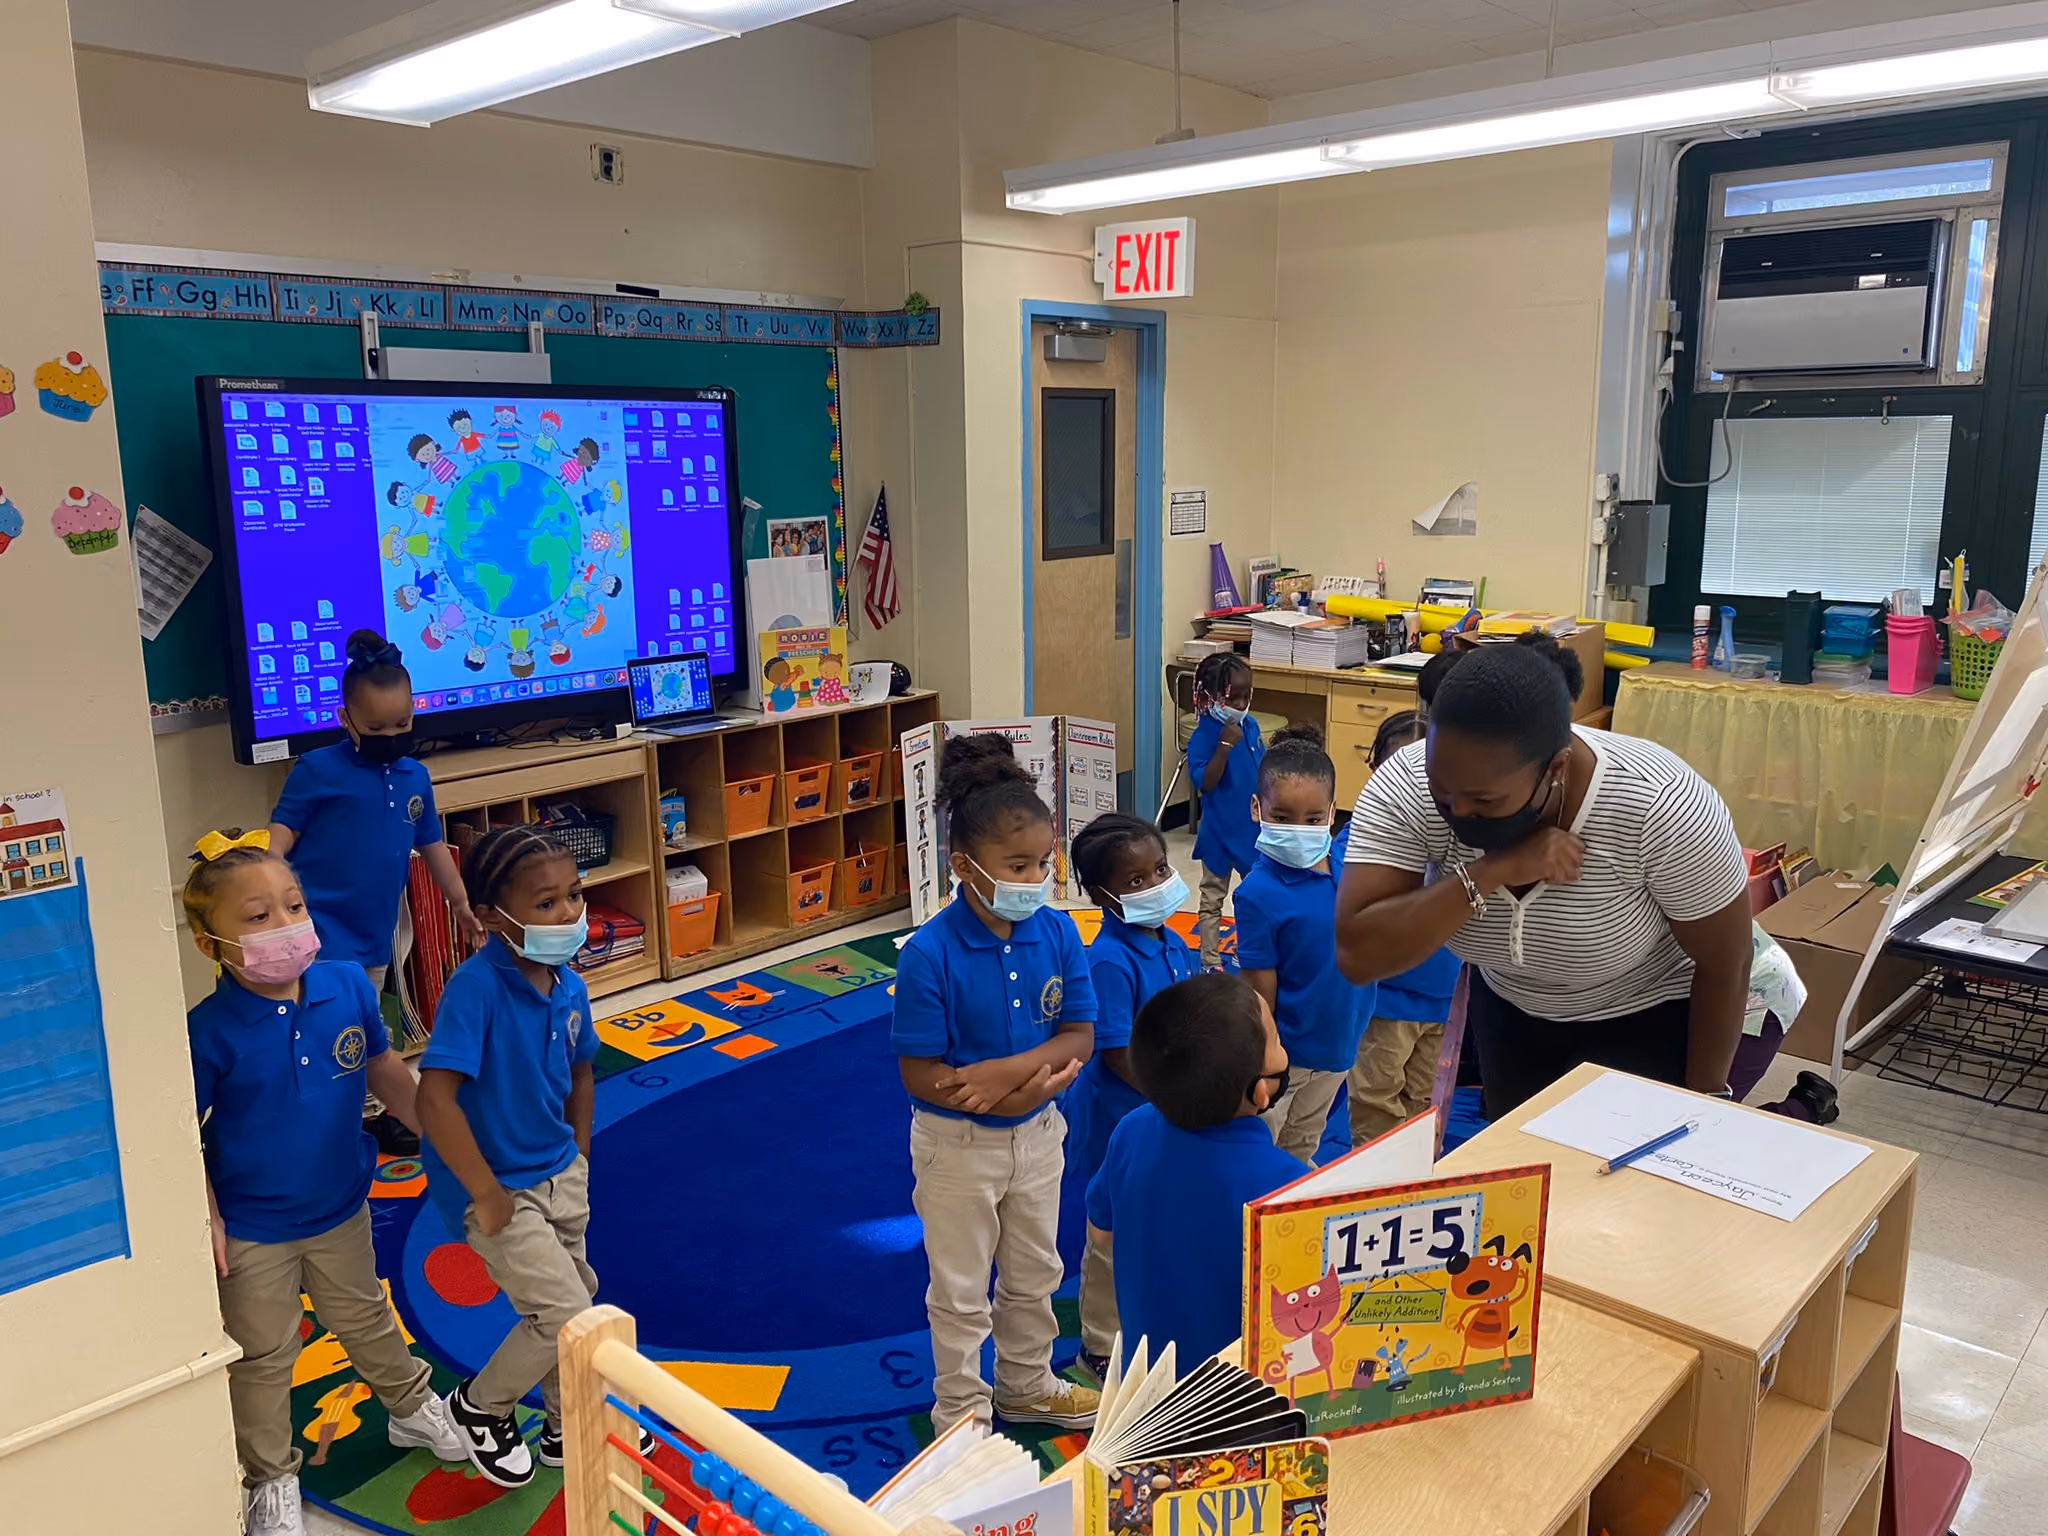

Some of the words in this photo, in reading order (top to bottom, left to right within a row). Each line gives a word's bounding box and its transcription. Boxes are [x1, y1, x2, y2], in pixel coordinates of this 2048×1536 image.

[1114, 230, 1181, 294] EXIT
[131, 278, 155, 302] Ff
[176, 280, 218, 312] Gg
[235, 284, 268, 309] Hh
[284, 288, 299, 311] Ii
[326, 290, 342, 318] Jj
[370, 292, 398, 316] Kk
[420, 296, 434, 318] Ll
[458, 297, 494, 321] Mm
[512, 301, 541, 322] Nn
[558, 303, 586, 325] Oo
[604, 306, 626, 330] Pp
[637, 308, 663, 333] Qq
[676, 311, 694, 331] Rr
[705, 313, 721, 332] Ss
[735, 315, 748, 333] Tt
[769, 317, 789, 335] Uu
[806, 319, 825, 337] Vv
[842, 320, 868, 337] Ww
[877, 320, 894, 337] Xx
[897, 318, 909, 340] Yy
[917, 318, 935, 336] Zz
[219, 378, 279, 390] Promethean
[52, 398, 81, 414] June
[1004, 729, 1030, 741] Rules
[1067, 726, 1098, 742] Classroom
[1098, 731, 1114, 746] Rules
[15, 790, 44, 802] school
[836, 967, 891, 987] Dd
[608, 1009, 666, 1032] Bb
[736, 1005, 785, 1022] Cc
[803, 1007, 842, 1024] 7
[627, 1071, 670, 1088] 6
[1680, 1170, 1756, 1202] Jayceon
[1375, 1295, 1392, 1305] and
[1394, 1295, 1422, 1304] Other
[1354, 1307, 1392, 1320] Unlikely
[1393, 1306, 1439, 1317] Additions
[1396, 1390, 1444, 1405] illustrated
[1445, 1385, 1456, 1397] by
[1458, 1381, 1490, 1394] Brenda
[1492, 1375, 1521, 1387] Sexton
[1309, 1404, 1363, 1423] LaRochelle
[1200, 1458, 1235, 1487] 2
[1300, 1453, 1329, 1487] 3
[1167, 1494, 1182, 1536] I
[1197, 1483, 1271, 1536] SPY
